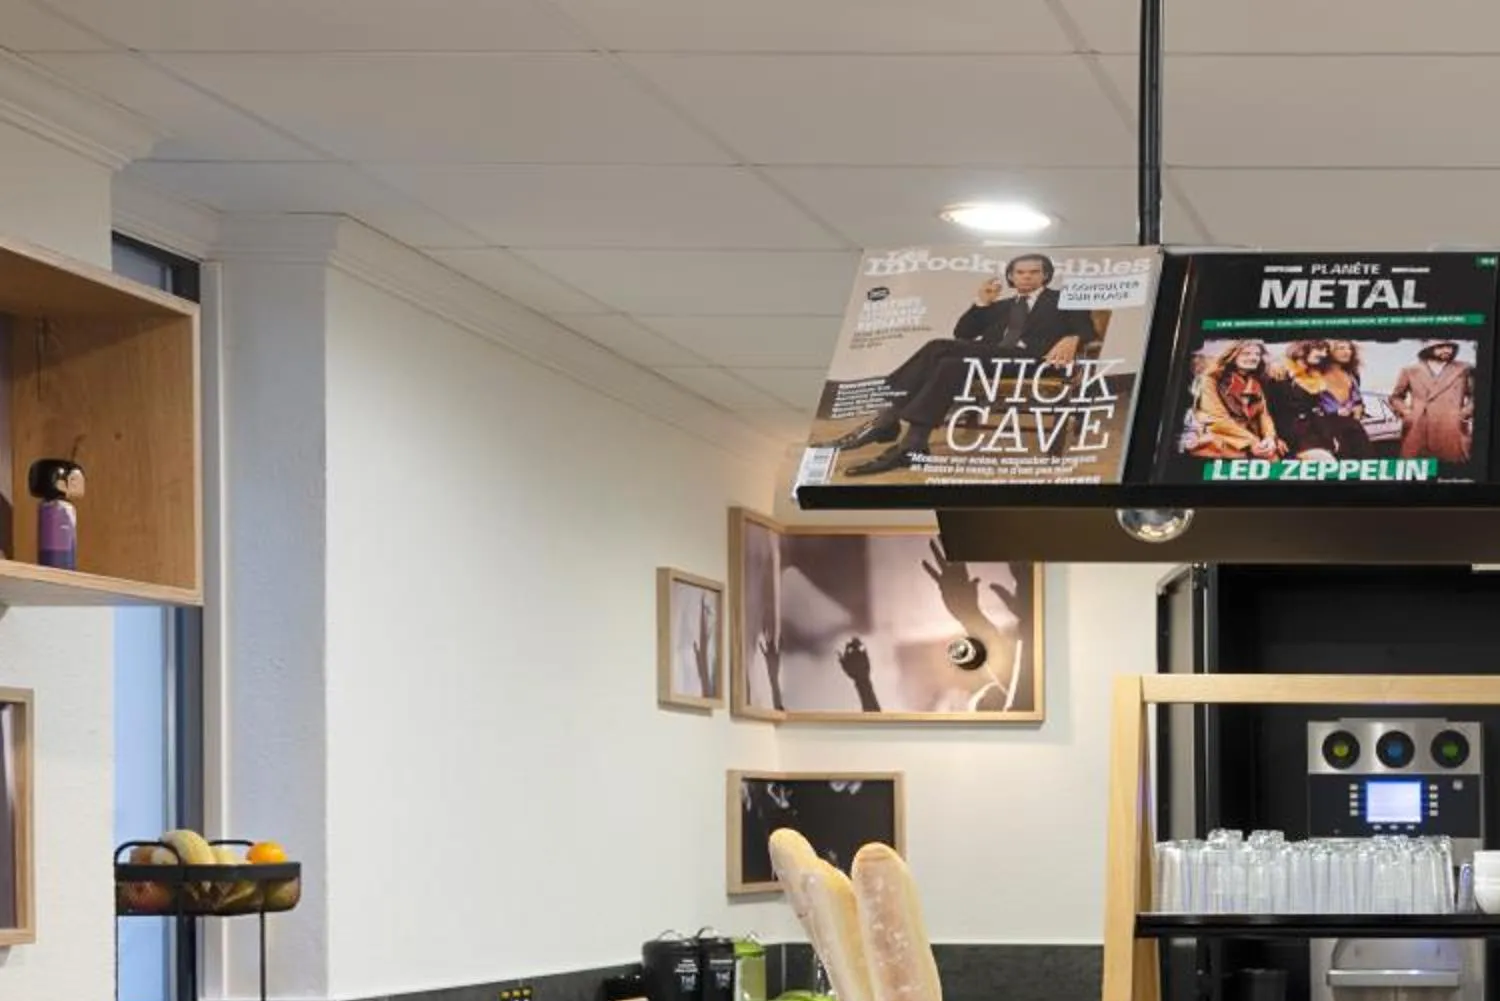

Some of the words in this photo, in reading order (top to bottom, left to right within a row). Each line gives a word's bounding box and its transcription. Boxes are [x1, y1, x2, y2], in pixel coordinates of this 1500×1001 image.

[1259, 279, 1427, 309] METAL
[953, 356, 1126, 402] NICK
[946, 404, 1115, 452] CAVE
[1212, 460, 1270, 480] LED
[1279, 459, 1428, 480] ZEPPELIN
